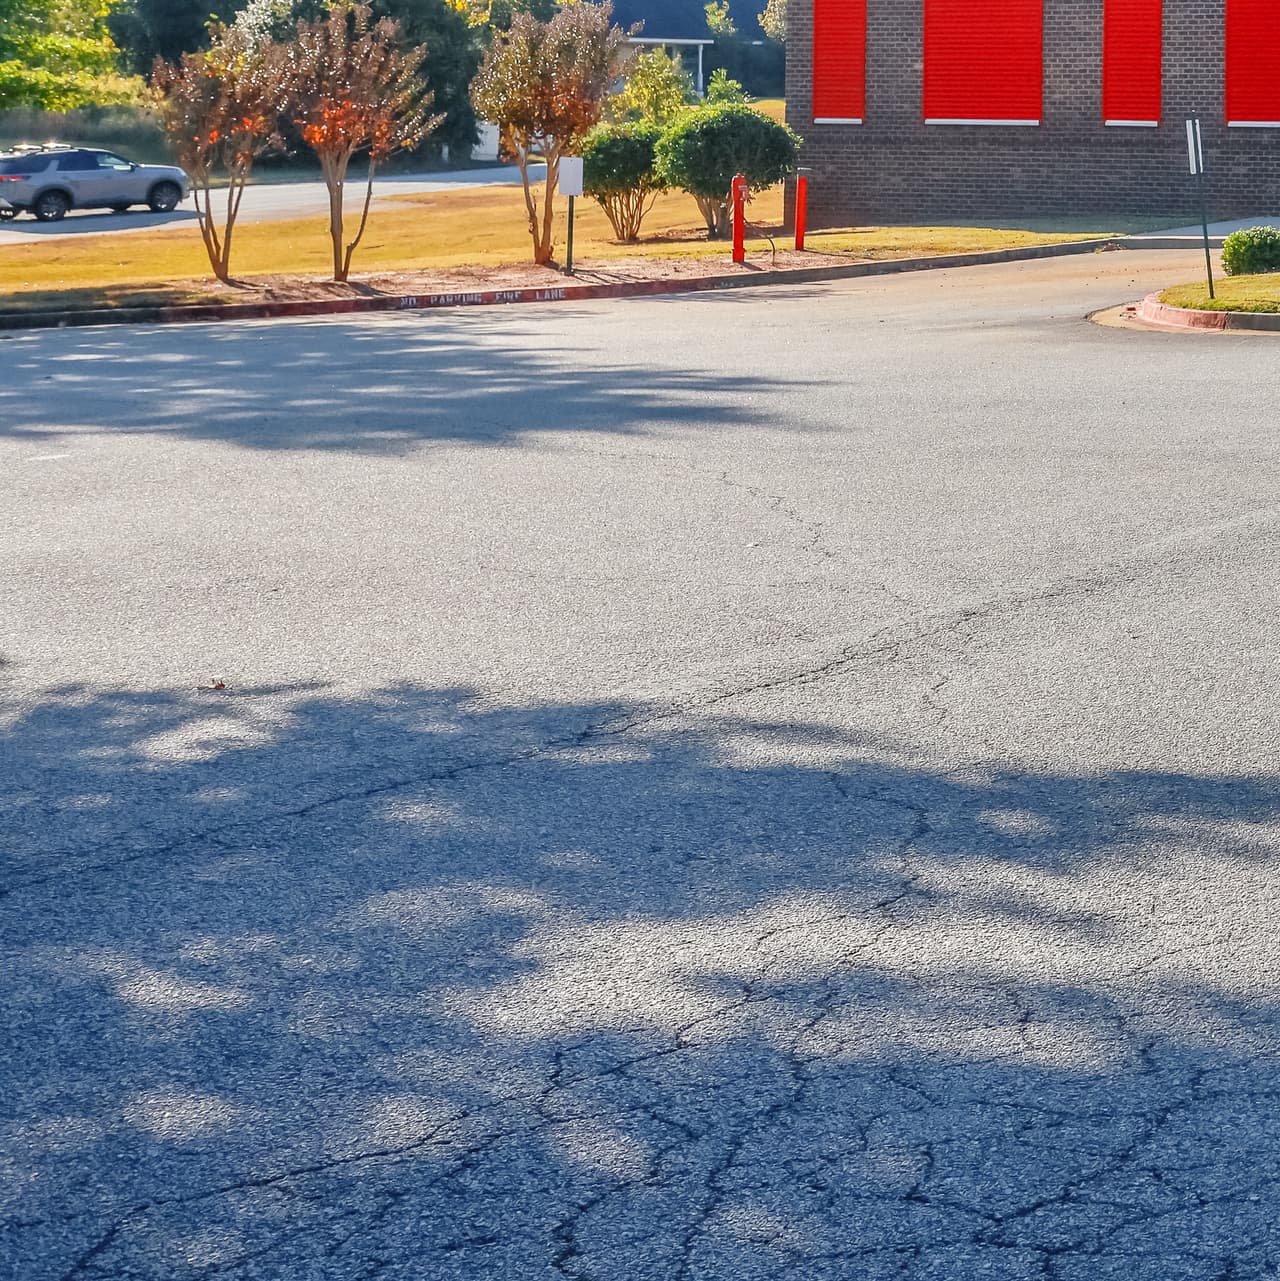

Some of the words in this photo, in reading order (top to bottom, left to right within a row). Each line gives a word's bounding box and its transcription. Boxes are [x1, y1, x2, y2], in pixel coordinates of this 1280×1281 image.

[430, 294, 482, 305] PARKING
[495, 291, 522, 301] FIRE
[536, 289, 566, 300] LANE
